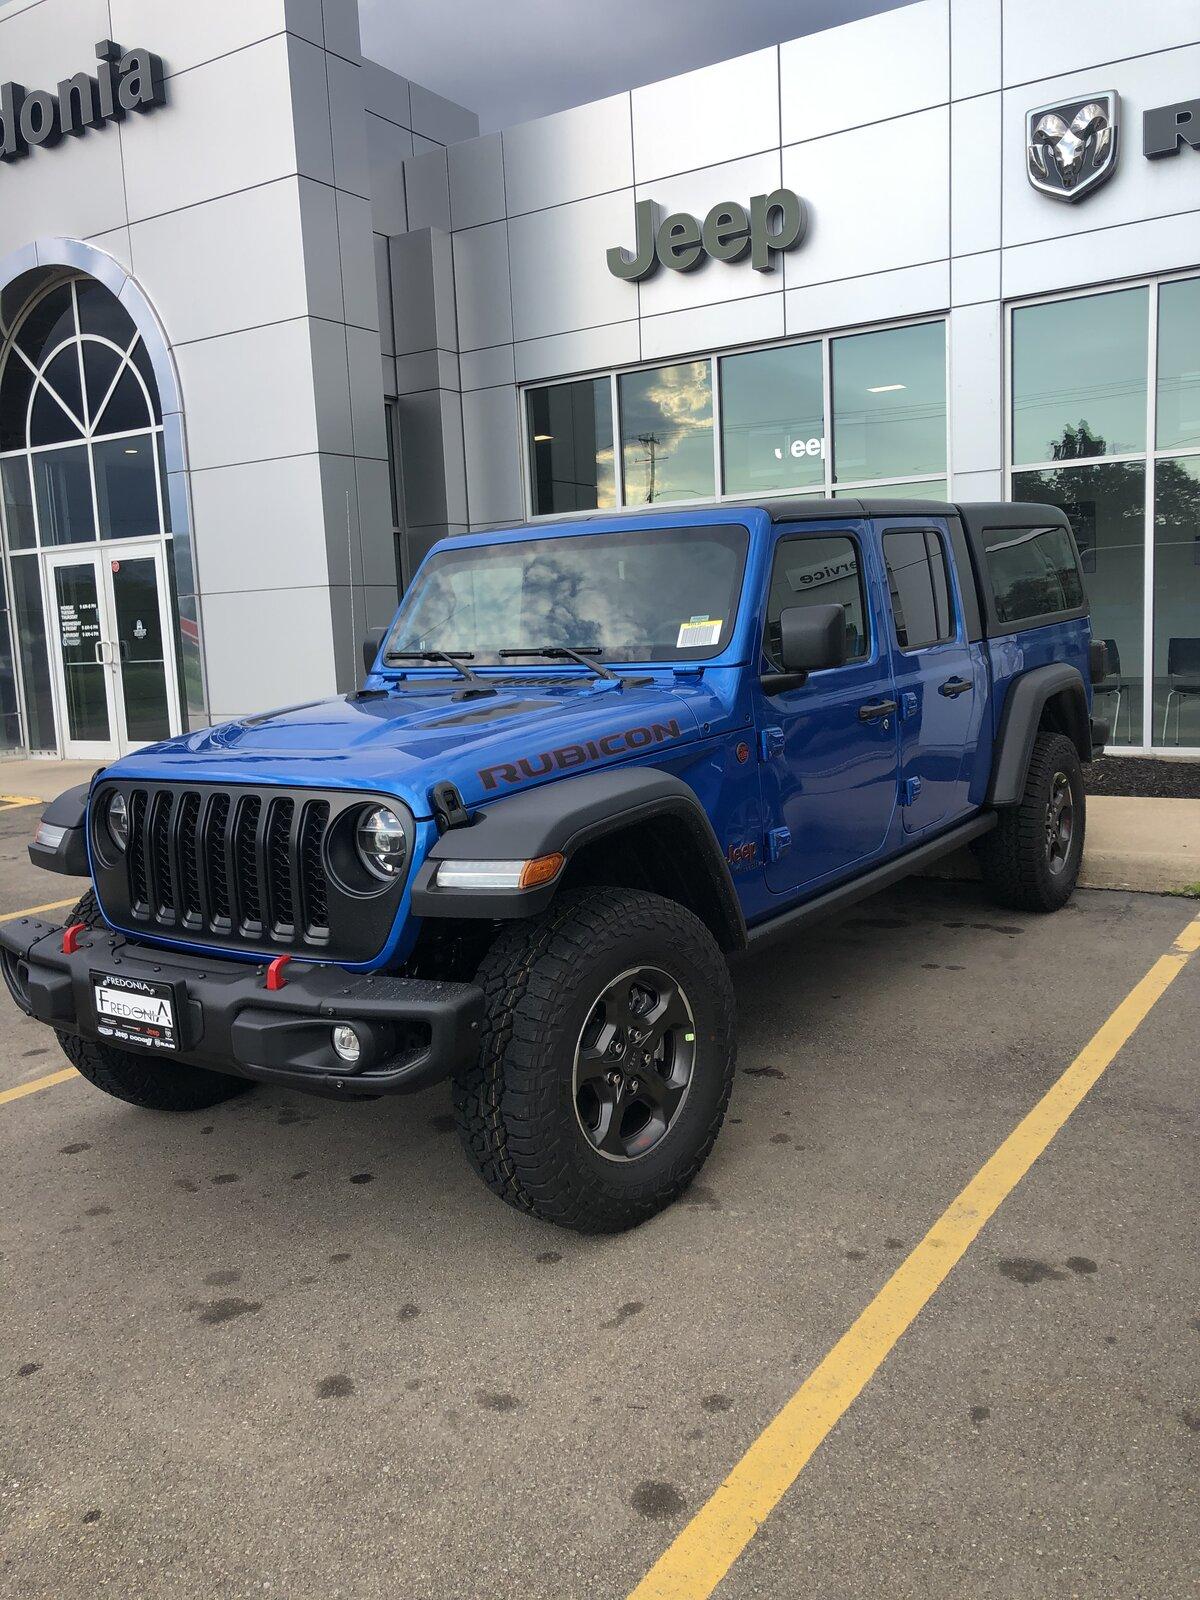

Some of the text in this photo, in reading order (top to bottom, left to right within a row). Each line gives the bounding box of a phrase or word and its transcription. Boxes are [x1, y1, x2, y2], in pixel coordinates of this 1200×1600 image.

[606, 188, 807, 283] Jeep
[478, 719, 681, 790] RUBICON
[106, 976, 150, 991] FREDONIA
